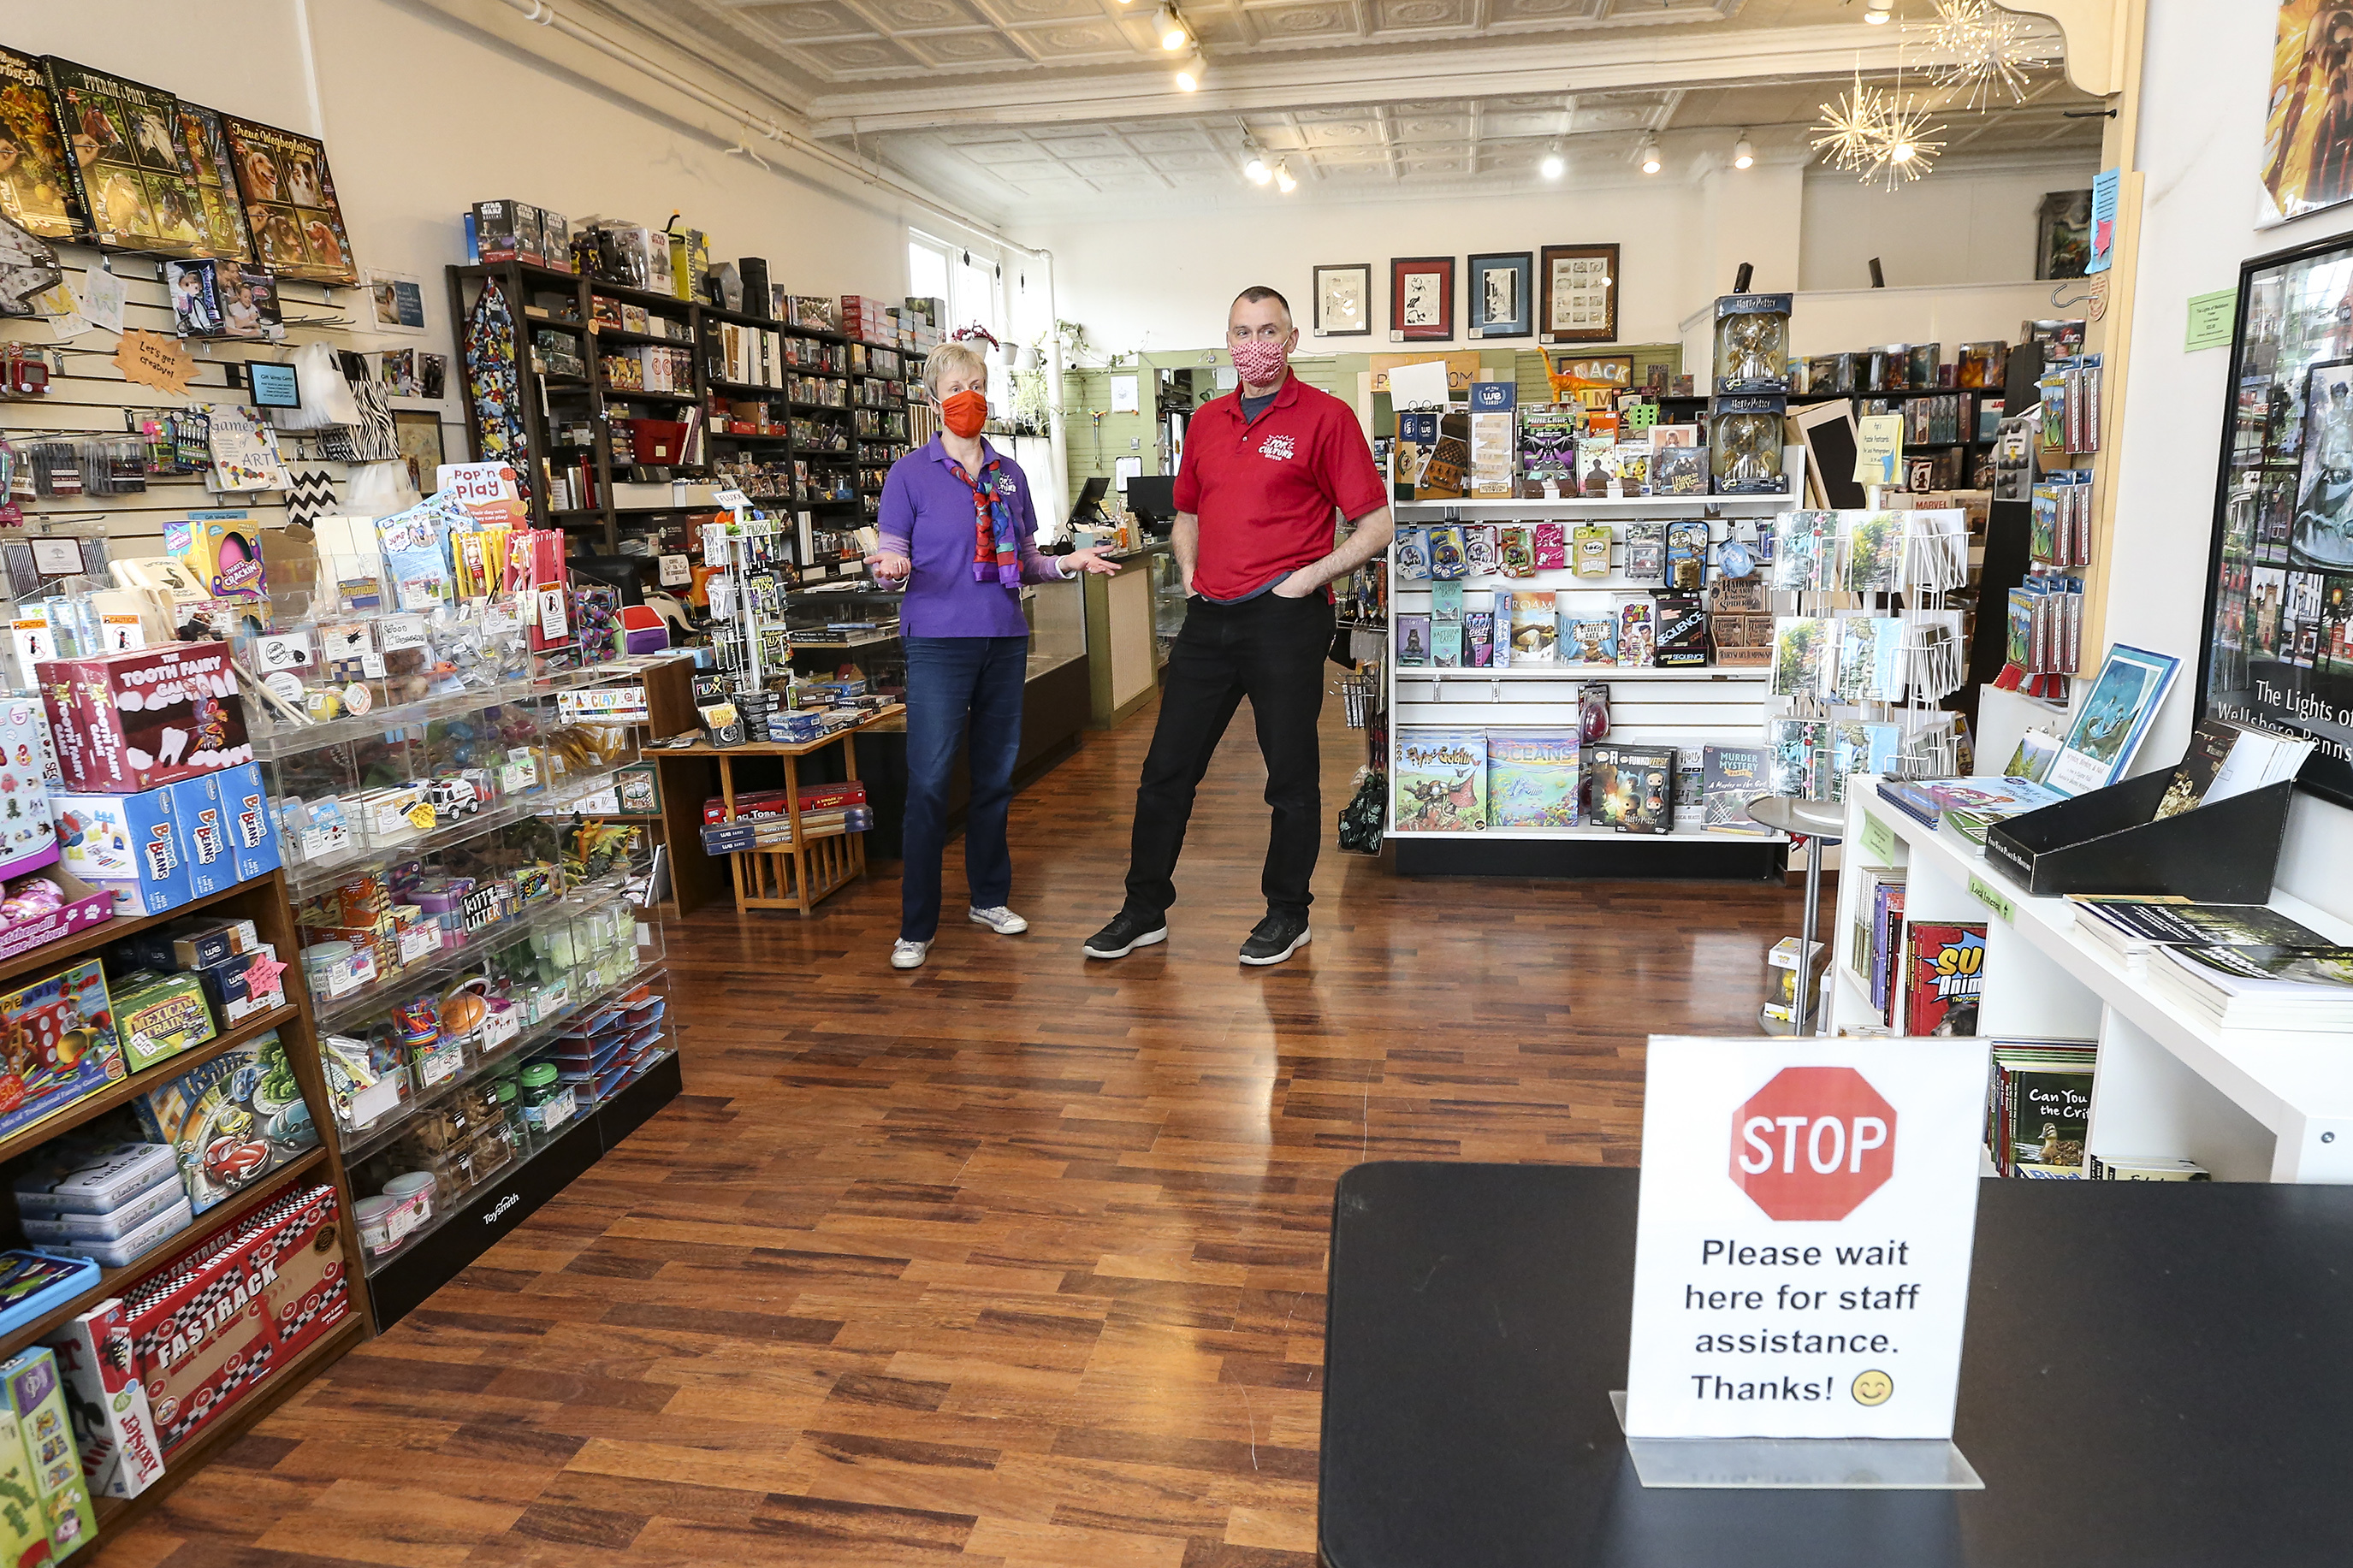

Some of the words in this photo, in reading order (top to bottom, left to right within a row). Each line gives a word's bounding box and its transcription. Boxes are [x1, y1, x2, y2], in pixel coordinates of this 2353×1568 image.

[82, 73, 120, 99] PFERDE
[126, 86, 148, 107] PONY
[232, 122, 260, 141] Treue
[260, 130, 316, 157] Wegbegleiter
[1736, 298, 1755, 308] Harry
[1756, 298, 1776, 307] Potter
[139, 340, 161, 358] Let's
[162, 355, 175, 365] get
[139, 356, 175, 378] creative!
[1732, 399, 1751, 410] Harry
[1751, 397, 1771, 408] Potter
[210, 417, 255, 434] Games
[240, 437, 249, 447] of
[1258, 446, 1294, 460] CULTURE
[1270, 439, 1288, 449] POP
[242, 453, 271, 466] ART
[456, 481, 499, 499] play
[719, 493, 744, 503] FLUXX
[1673, 482, 1686, 494] Kill
[1685, 478, 1699, 488] You
[1916, 505, 1949, 514] MARVEL
[388, 531, 406, 545] JUMP
[747, 524, 769, 535] FLUXX
[224, 561, 258, 586] CRACKIN'
[1512, 601, 1553, 609] ROAM
[1657, 611, 1704, 646] SEQUENCE
[160, 652, 181, 664] THE
[121, 664, 178, 687] TOOTH
[179, 655, 222, 677] FAIRY
[591, 693, 617, 707] CLAY
[696, 680, 723, 696] FLUXX
[2255, 679, 2282, 707] The
[2285, 689, 2332, 722] Lights
[55, 723, 70, 756] GAME
[59, 701, 77, 743] TOOTH
[70, 745, 86, 780] FAIRY
[90, 723, 106, 756] GAME
[94, 701, 113, 743] TOOTH
[105, 745, 123, 781] FAIRY
[1495, 747, 1573, 761] OCEANS
[1628, 755, 1668, 766] FUNKOVERSE
[1718, 760, 1759, 772] MYSTERY
[1720, 751, 1758, 763] MURDER
[240, 812, 260, 848] BEANS
[151, 823, 177, 868] Balance
[194, 826, 216, 864] BEANS
[148, 841, 169, 880] BEANS
[464, 885, 496, 916] KITTY
[1971, 883, 1984, 900] Local
[465, 902, 501, 932] LITTER
[1935, 946, 1983, 976] SU
[132, 998, 197, 1034] MEXICAN
[142, 1014, 186, 1038] TRAIN
[25, 1096, 61, 1116] Traditional
[2029, 1089, 2060, 1104] Can
[2061, 1089, 2088, 1104] You
[2041, 1105, 2060, 1116] the
[1739, 1115, 1888, 1175] STOP
[83, 1156, 139, 1187] Clades
[112, 1182, 141, 1202] Clades
[119, 1208, 147, 1228] Clades
[483, 1193, 520, 1225] Toysmith
[127, 1234, 156, 1254] Clades
[170, 1228, 234, 1278] FASTRACK
[1701, 1240, 1823, 1266] Please
[1835, 1240, 1910, 1266] wait
[1685, 1284, 1763, 1311] here
[1776, 1284, 1828, 1311] for
[1838, 1284, 1921, 1311] staff
[157, 1255, 281, 1370] FASTRACK
[1695, 1328, 1900, 1354] assistance.
[1691, 1376, 1834, 1402] Thanks!
[119, 1412, 160, 1485] Twister
